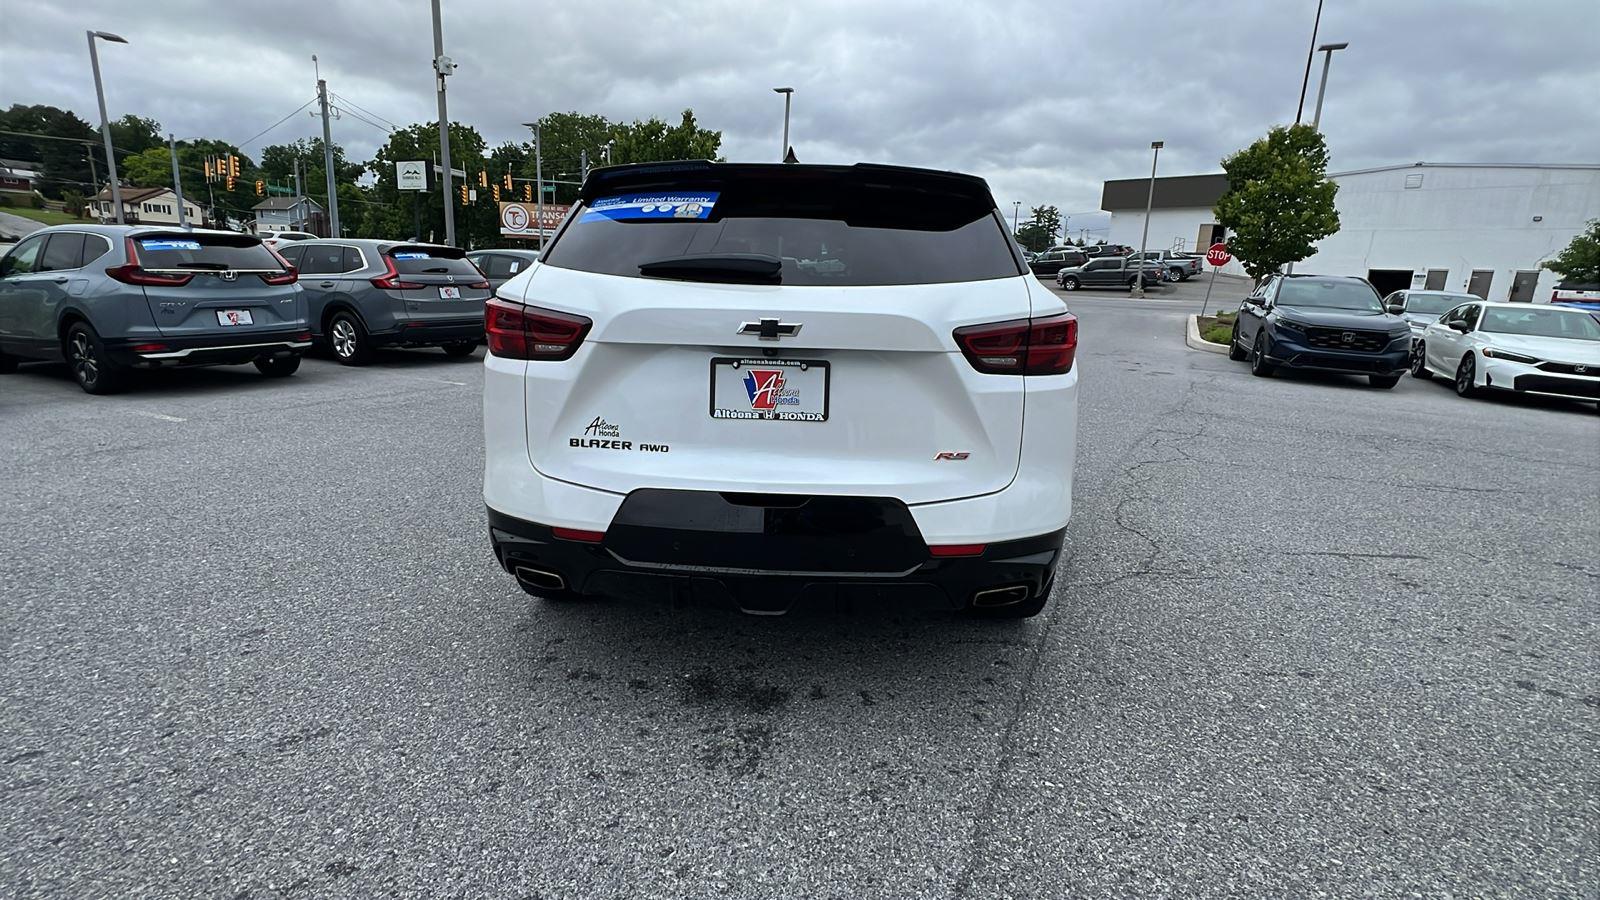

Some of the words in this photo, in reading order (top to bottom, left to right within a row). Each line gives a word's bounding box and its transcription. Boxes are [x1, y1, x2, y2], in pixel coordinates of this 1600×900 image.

[632, 196, 666, 204] Limited
[667, 196, 711, 204] Warranty
[1208, 250, 1231, 260] STOP
[771, 396, 800, 405] Honda
[714, 409, 760, 419] Altoona
[779, 411, 825, 421] HONDA
[599, 430, 620, 438] Honda
[569, 438, 632, 451] BLAZER
[639, 443, 669, 453] AWD
[933, 451, 971, 461] RS
